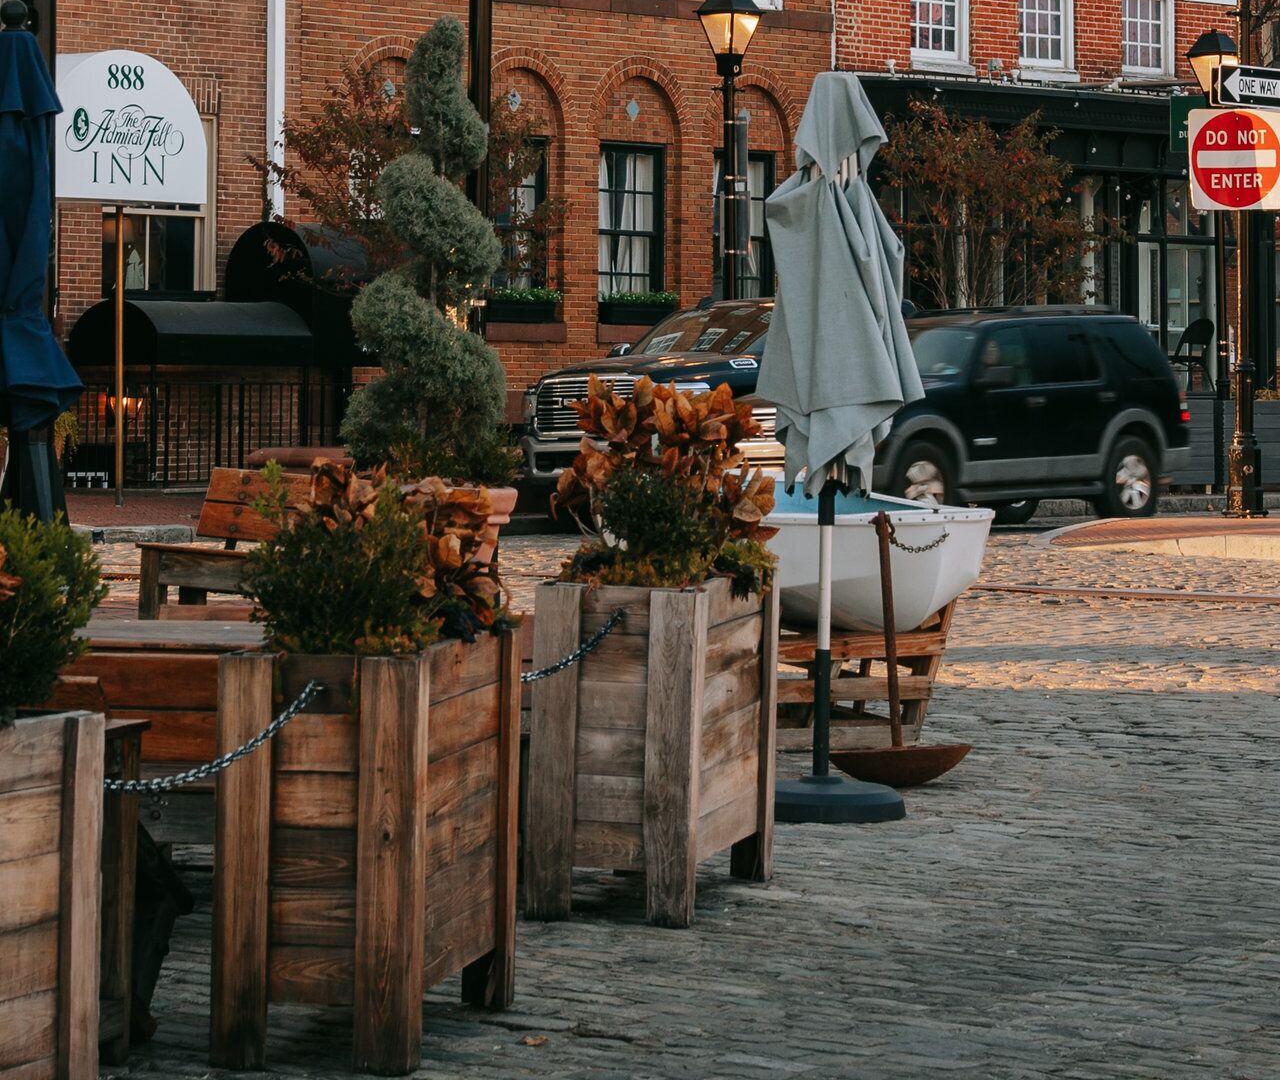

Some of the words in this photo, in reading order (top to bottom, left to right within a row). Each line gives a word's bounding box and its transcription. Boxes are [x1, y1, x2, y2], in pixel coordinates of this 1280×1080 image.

[107, 63, 145, 91] 888
[1238, 78, 1256, 94] ONE
[1259, 80, 1278, 96] WAY
[65, 109, 150, 153] Admiral
[128, 115, 185, 159] Fell
[1205, 130, 1228, 146] DO
[1237, 129, 1267, 145] NOT
[92, 151, 166, 186] INN
[1210, 173, 1263, 189] ENTER
